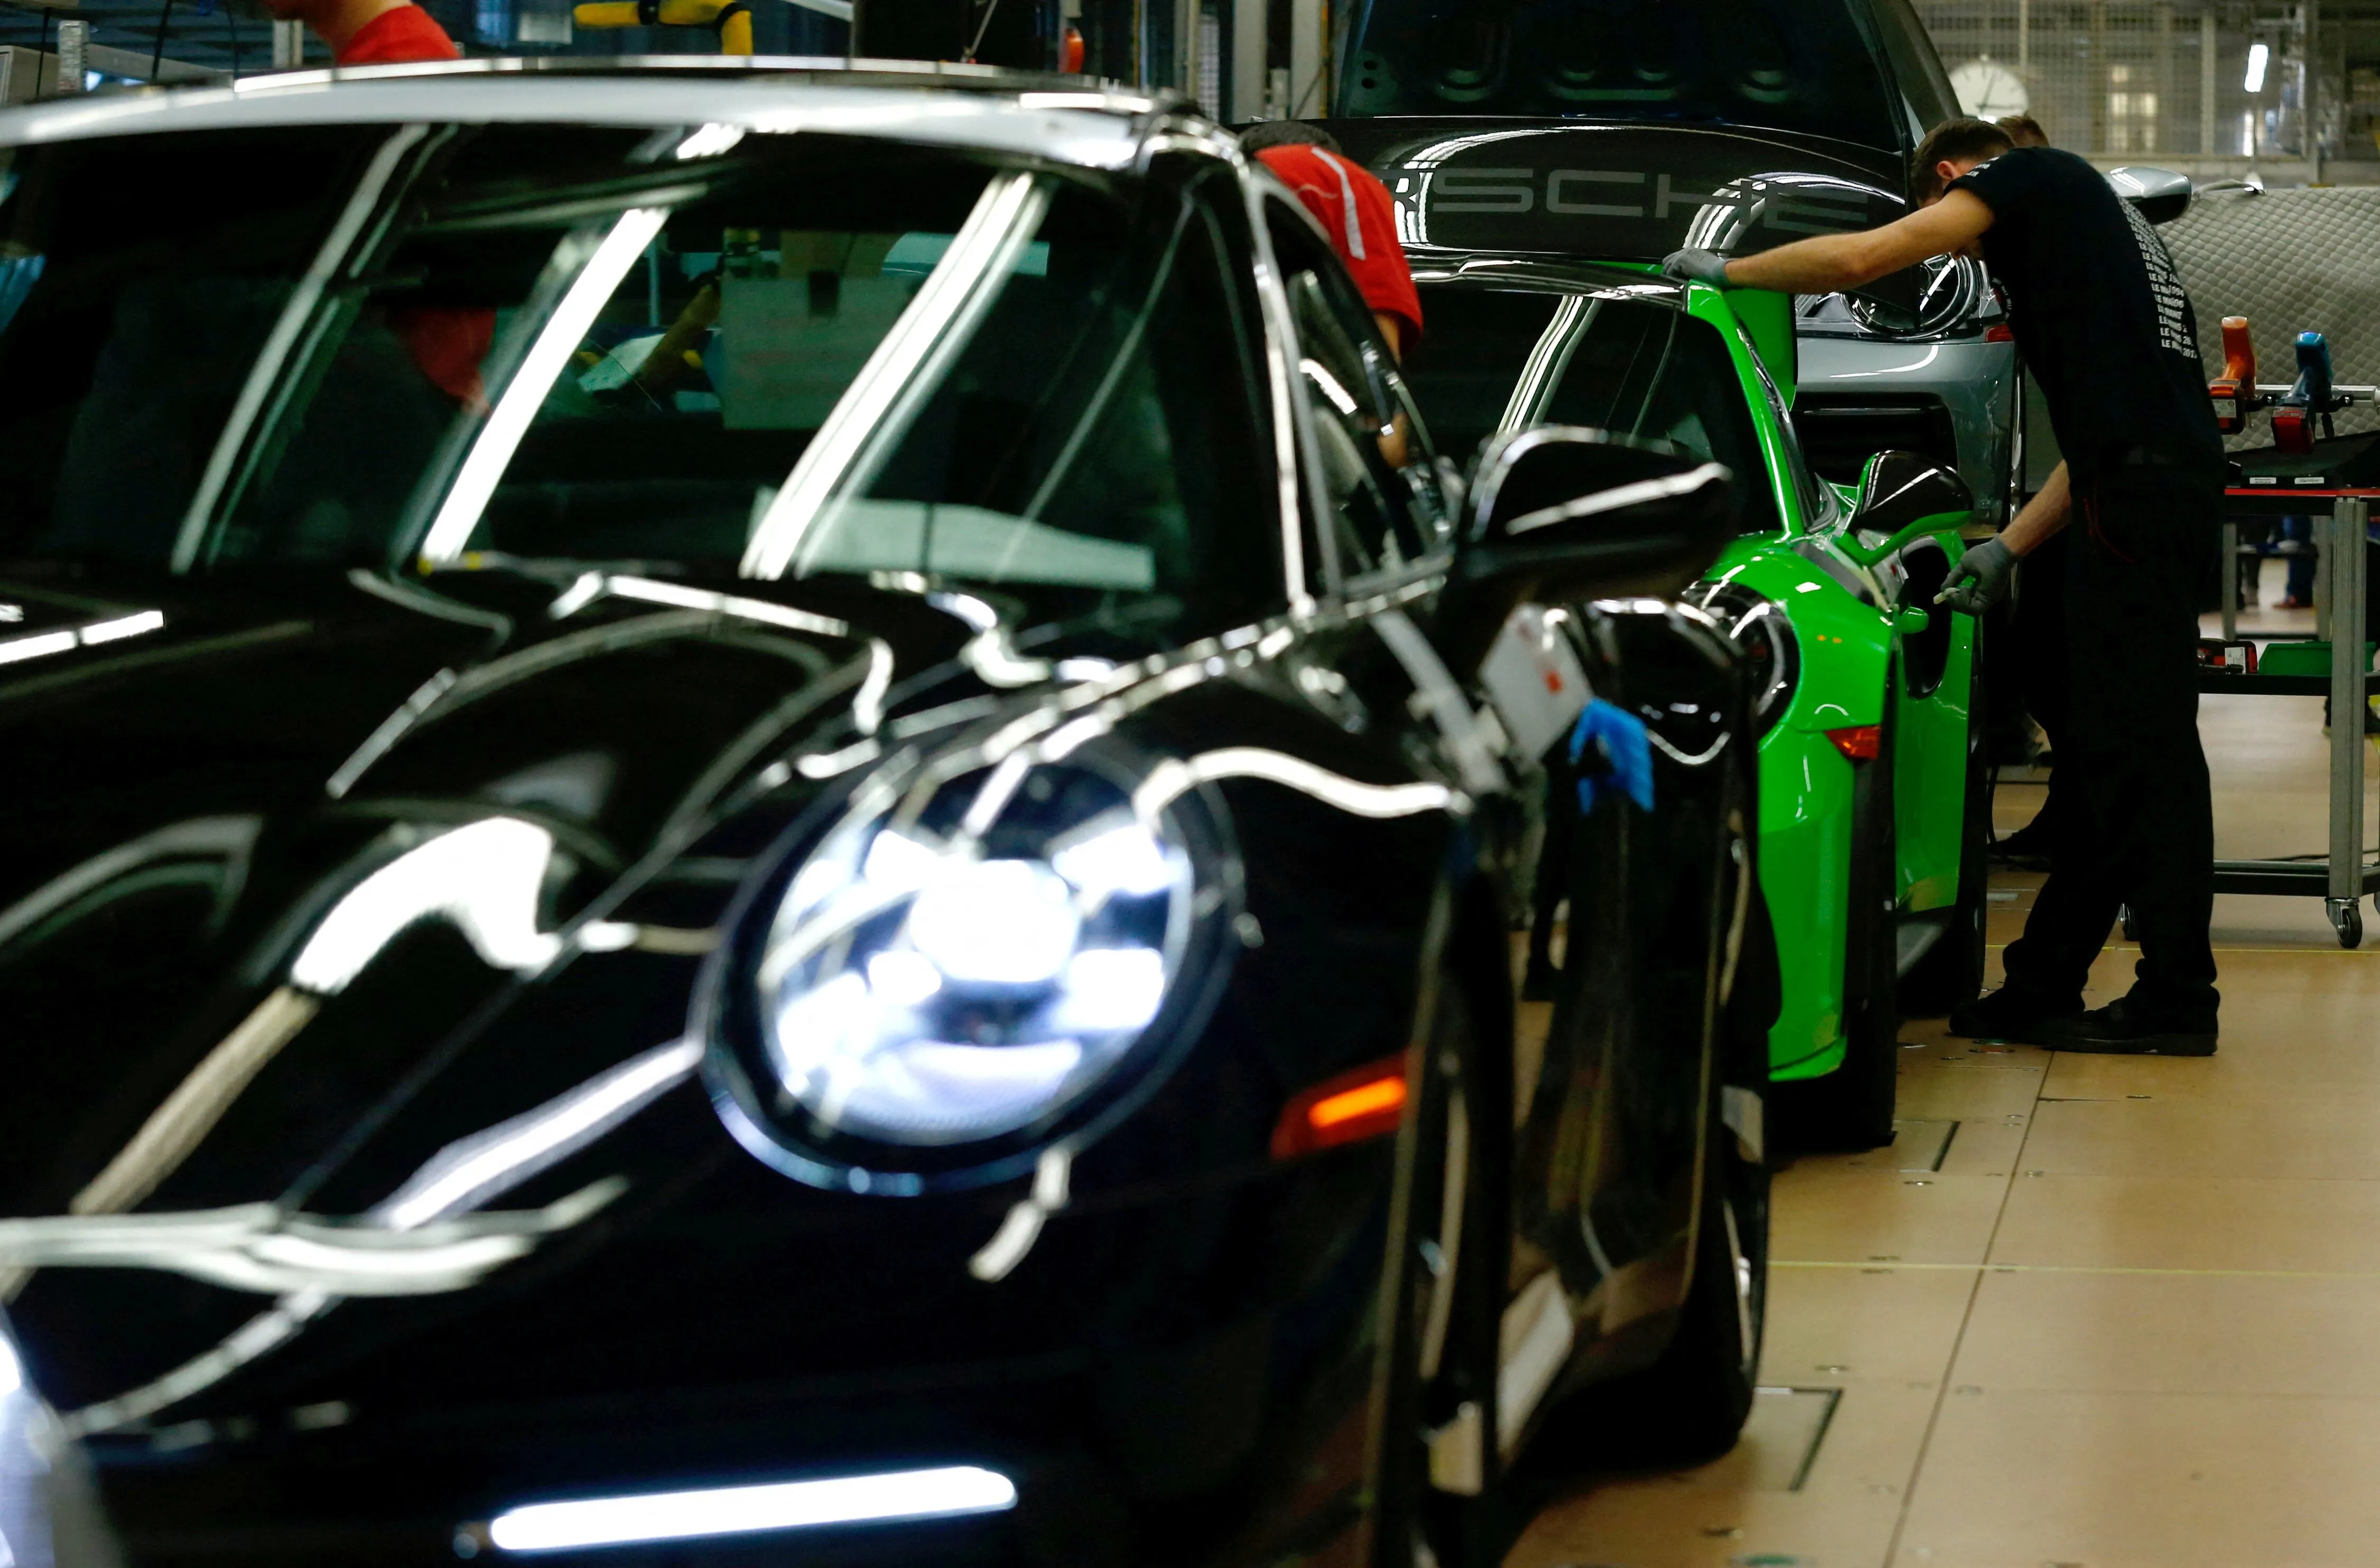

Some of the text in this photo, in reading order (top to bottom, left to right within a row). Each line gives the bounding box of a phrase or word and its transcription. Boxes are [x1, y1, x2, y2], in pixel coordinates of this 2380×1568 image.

[1372, 167, 1868, 235] RSCHE
[2159, 315, 2168, 324] LE
[2160, 327, 2170, 336] LE
[2161, 339, 2171, 348] LE
